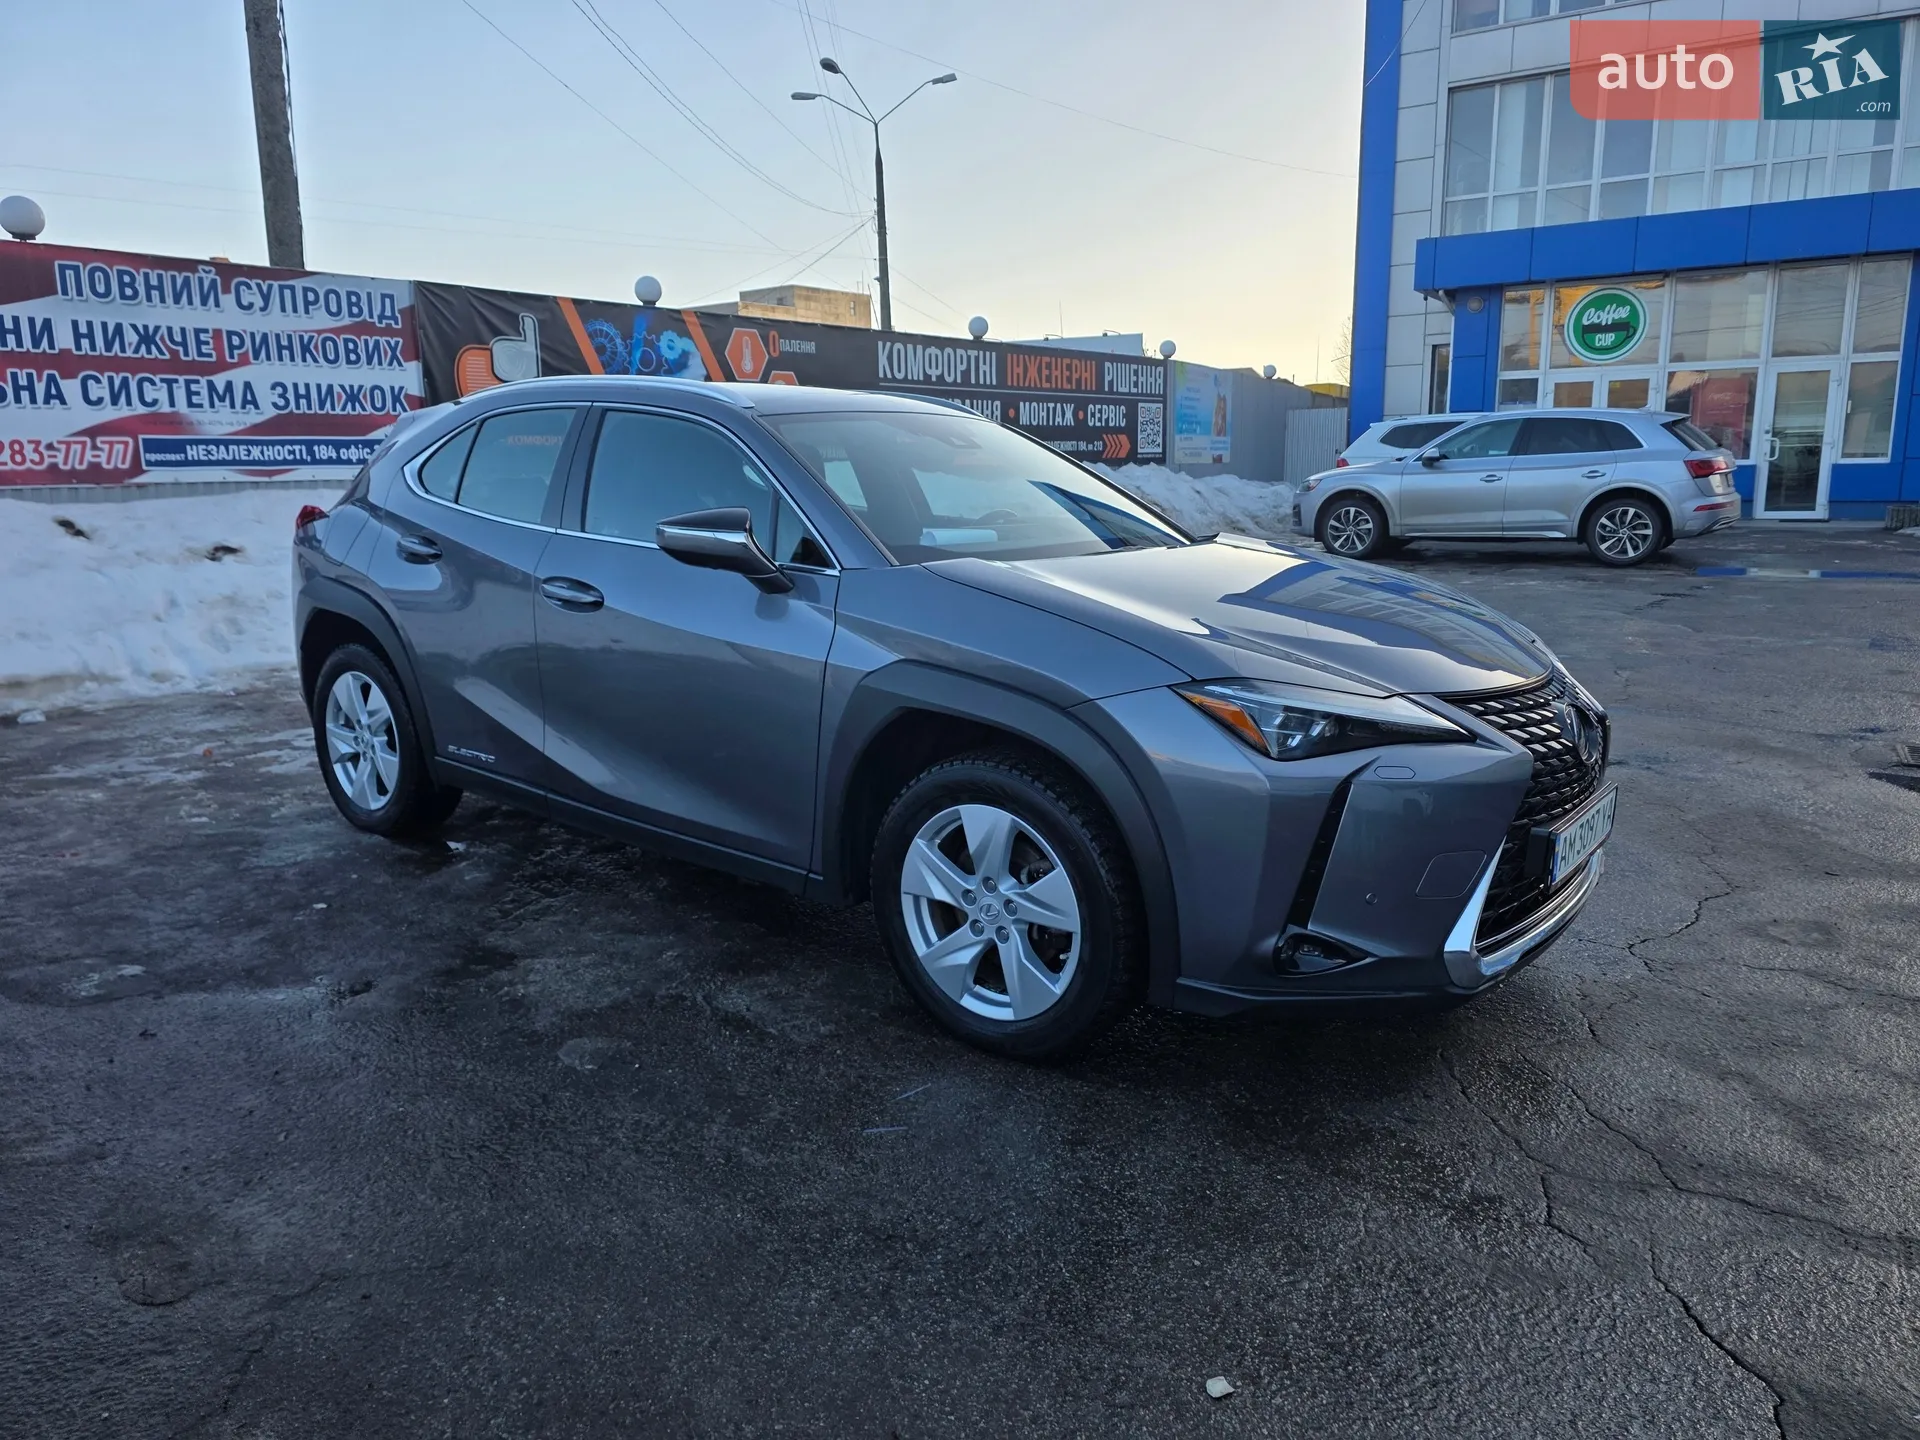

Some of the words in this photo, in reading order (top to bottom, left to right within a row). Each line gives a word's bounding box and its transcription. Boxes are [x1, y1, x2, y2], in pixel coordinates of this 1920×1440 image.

[56, 262, 222, 310] ПОВНИЙ
[233, 280, 400, 327] СУПРОВІД
[1582, 303, 1631, 326] Coffee
[0, 313, 57, 351] НИ
[70, 318, 215, 360] НИЖЧЕ
[225, 330, 404, 369] РИНКОВИХ
[1595, 333, 1616, 347] CUP
[877, 340, 997, 386] КОМФОРТНІ
[1007, 353, 1096, 391] ІНЖЕНЕРНІ
[1104, 361, 1164, 395] РІШЕННЯ
[80, 373, 261, 411] СИСТЕМА
[269, 381, 409, 414] ЗНИЖОК
[1019, 401, 1075, 427] МОНТАЖ
[1087, 404, 1126, 428] СЕРВІС
[185, 444, 311, 462] НЕЗАЛЕЖНОСТІ,
[313, 445, 337, 460] 184
[340, 443, 371, 463] офіс
[1558, 827, 1578, 872] AM
[1576, 807, 1601, 855] 3097
